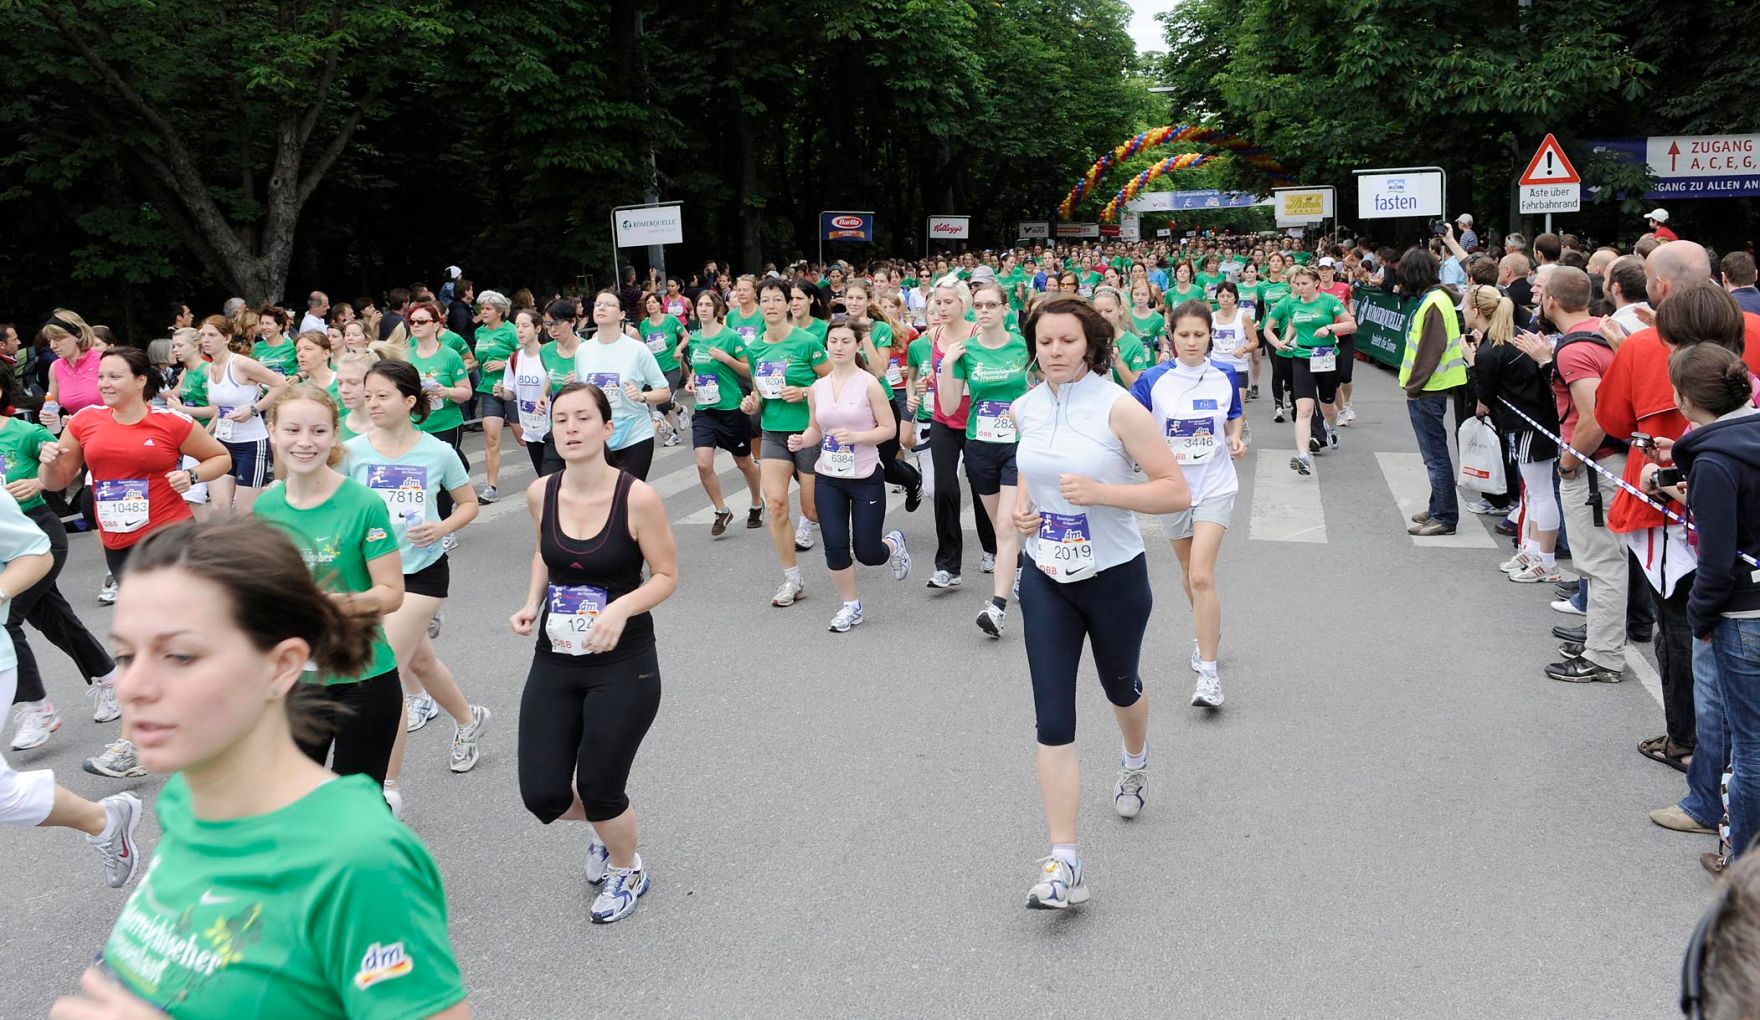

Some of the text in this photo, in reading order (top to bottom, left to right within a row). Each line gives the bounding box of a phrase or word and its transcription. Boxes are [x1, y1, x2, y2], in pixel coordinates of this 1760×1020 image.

[1691, 140, 1753, 154] ZUGANG
[1690, 156, 1757, 171] A, C, E, G,
[1689, 182, 1704, 191] ZU
[1707, 181, 1740, 190] ALLEN
[1529, 187, 1570, 197] Äste über
[1375, 194, 1417, 210] fasten
[1521, 199, 1578, 210] Fahrbahnrand
[838, 218, 860, 226] Barilla
[933, 223, 962, 234] Kellogg's
[519, 375, 539, 384] BDO
[1184, 437, 1214, 448] 3446
[831, 454, 853, 464] 6384
[404, 477, 420, 487] dm
[127, 489, 142, 498] dm
[388, 490, 424, 503] 7818
[111, 502, 147, 513] 10483
[1064, 529, 1082, 539] dm
[1054, 545, 1092, 561] 2019
[580, 599, 598, 611] dm
[364, 942, 402, 971] dm
